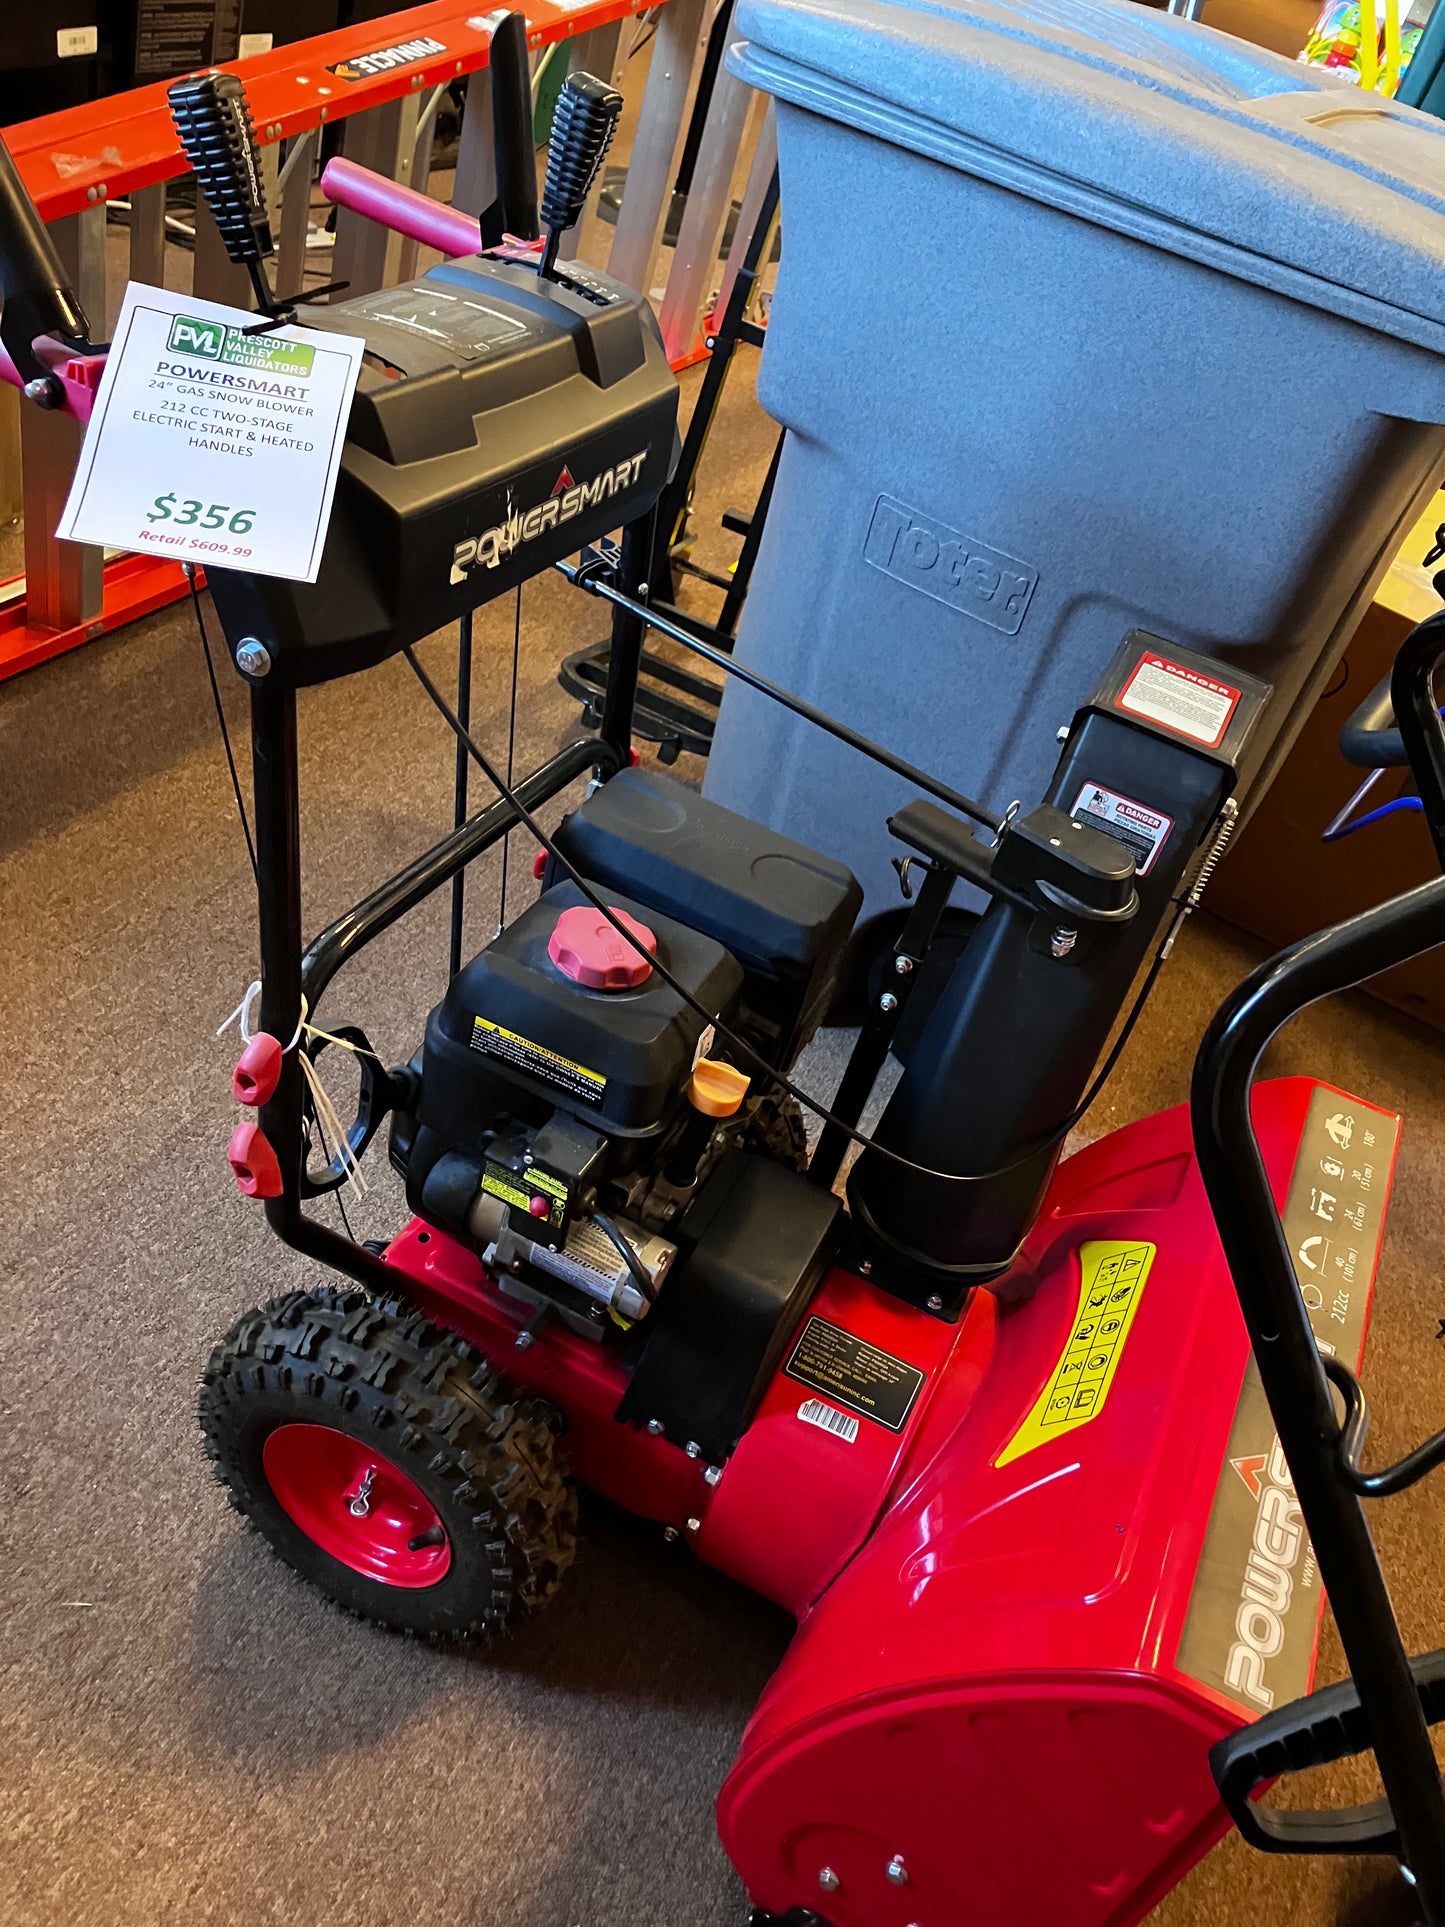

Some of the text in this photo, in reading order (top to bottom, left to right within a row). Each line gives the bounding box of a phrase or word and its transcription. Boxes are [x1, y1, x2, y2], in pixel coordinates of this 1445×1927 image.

[350, 37, 447, 74] PINNACLE
[172, 324, 218, 353] PVL
[225, 341, 274, 359] VALLEY
[228, 328, 298, 353] PRESCOTT
[223, 351, 308, 375] LIQUIDATORS
[156, 361, 310, 400] POWERSMART
[160, 400, 293, 433] 212 CC TWO-STAGE
[176, 384, 204, 398] GAS
[208, 390, 252, 406] SNOW
[256, 399, 314, 417] BLOWER
[132, 410, 314, 452] ELECTRIC START & HEATED
[188, 436, 253, 457] HANDLES
[146, 492, 257, 534] $356
[451, 450, 648, 582] POWERSMART
[138, 530, 252, 557] Retail $609.99
[874, 502, 1029, 612] Toter
[1166, 665, 1230, 696] DANGER
[1125, 806, 1161, 828] DANGER
[509, 1033, 579, 1071] CAUTION/ATTENTION
[1335, 1256, 1346, 1269] 40
[1330, 1289, 1350, 1325] 212cc
